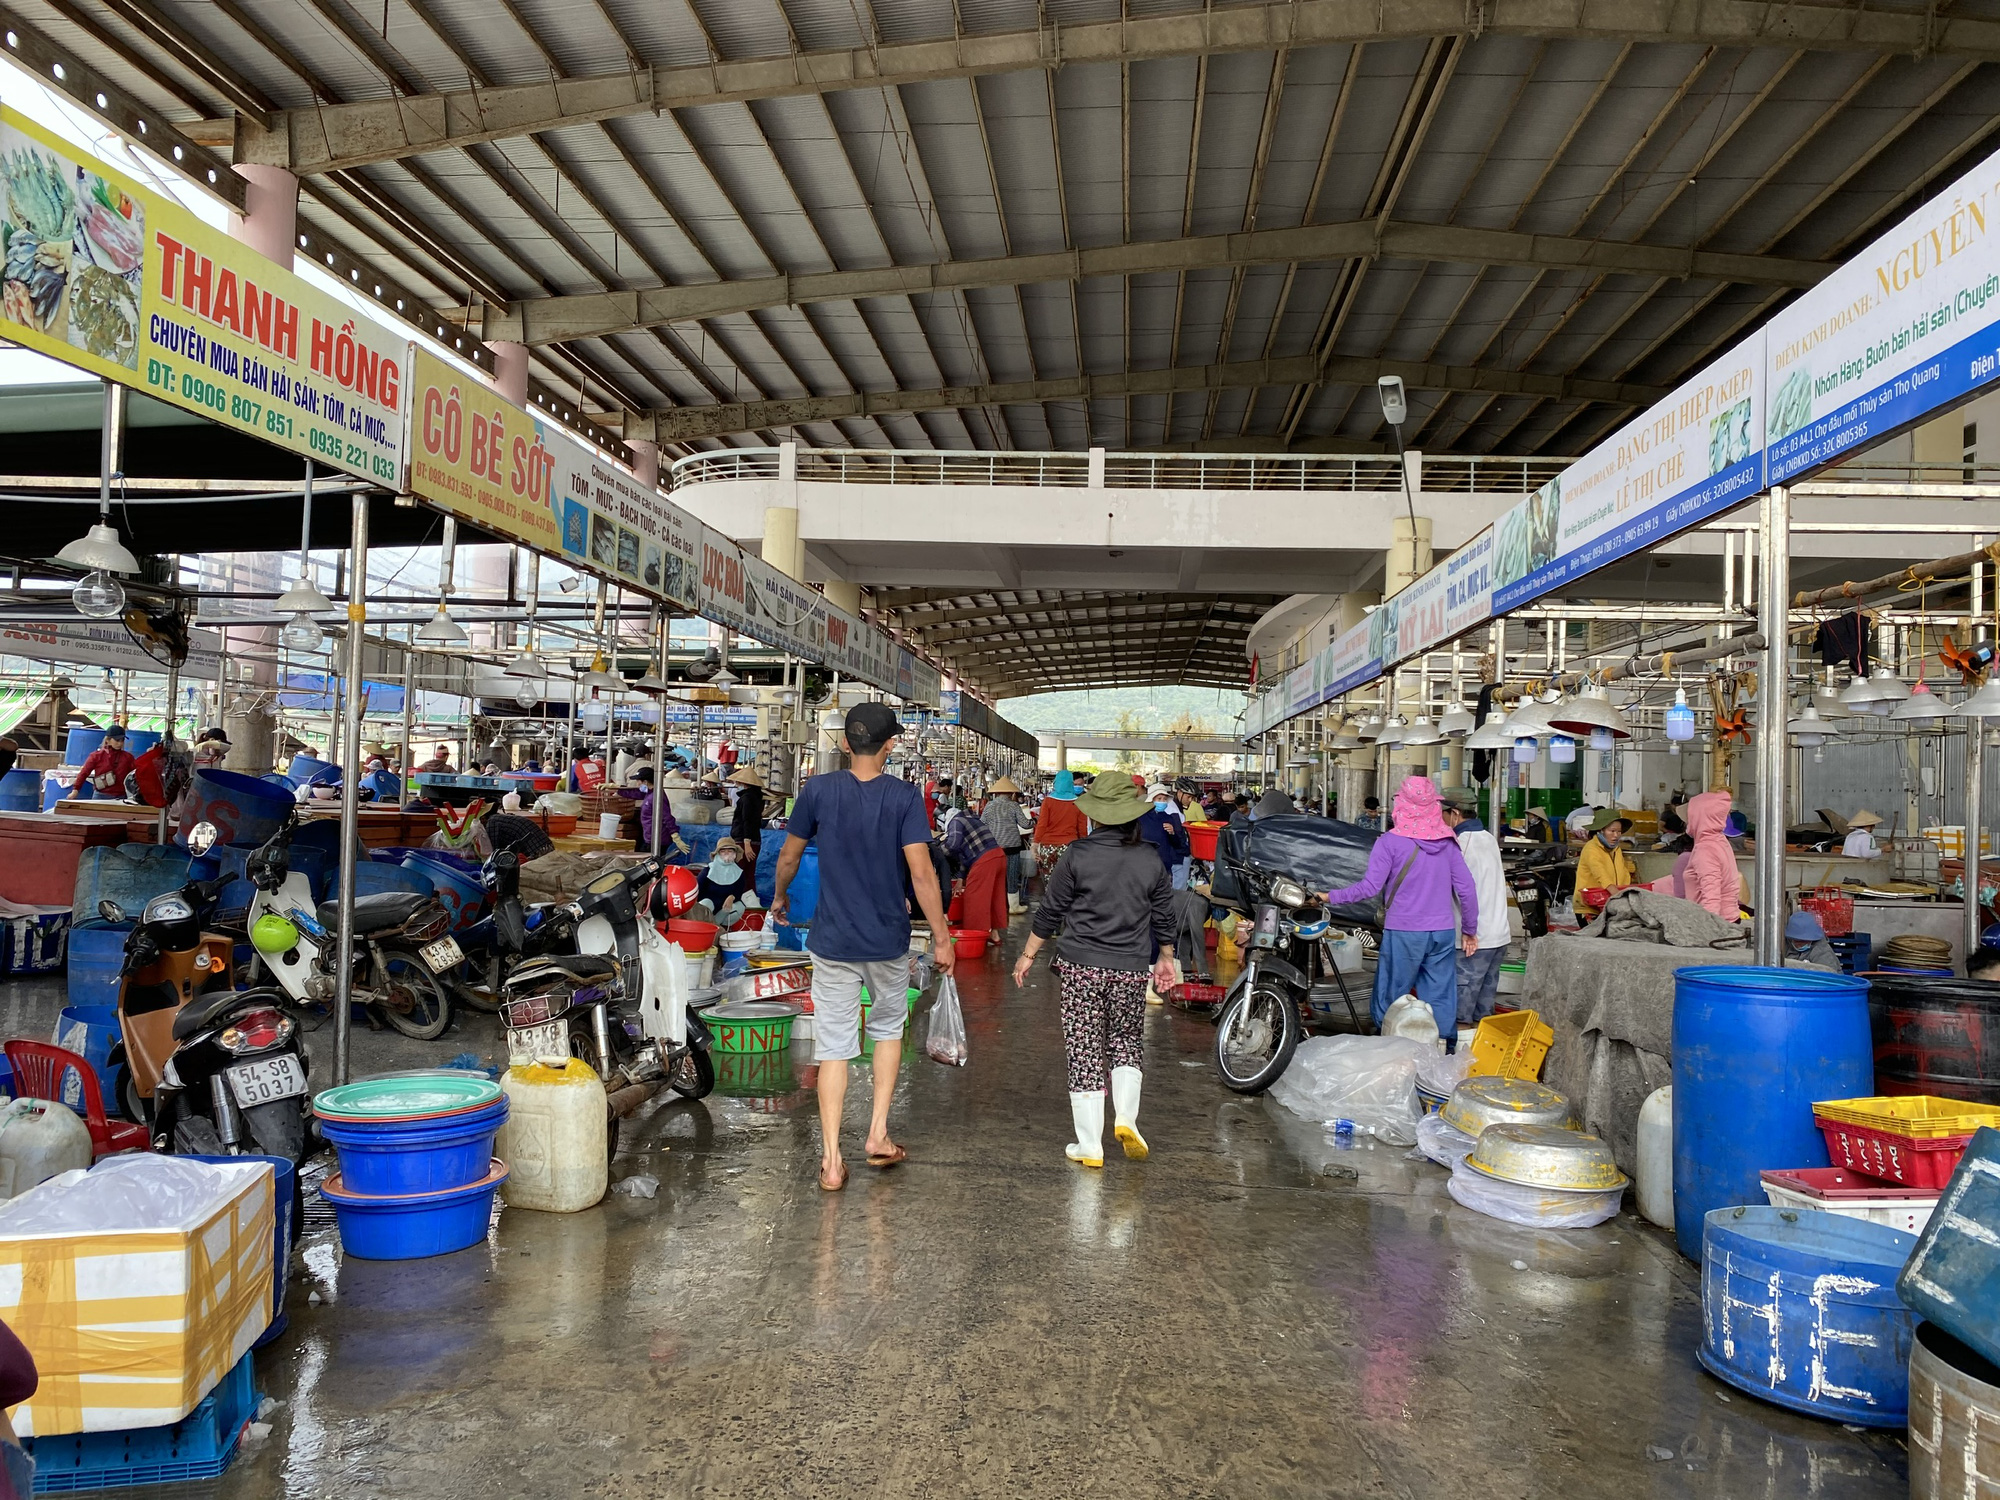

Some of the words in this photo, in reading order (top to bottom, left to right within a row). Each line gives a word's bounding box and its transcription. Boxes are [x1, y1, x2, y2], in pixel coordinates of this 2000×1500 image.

[1875, 192, 1987, 306] NGUYỄN
[156, 232, 299, 365] THANH
[310, 319, 399, 413] HỒNG
[1802, 322, 1827, 353] KINH
[1830, 293, 1872, 336] DOANH:
[1815, 371, 1838, 399] Nhóm
[1840, 357, 1864, 386] Hàng:
[1867, 339, 1889, 369] Buôn
[1892, 327, 1910, 354] bán
[1913, 313, 1929, 340] hải
[1931, 302, 1951, 331] sản
[1954, 273, 1999, 322] (Chuyên
[150, 314, 206, 365] CHUYÊN
[210, 341, 239, 380] MUA
[242, 355, 268, 392] BÁN
[271, 365, 291, 402] HẢI
[293, 376, 319, 415] SẢN:
[323, 392, 347, 430] TÔM,
[350, 405, 362, 435] CÁ
[1971, 354, 1995, 380] Điện
[147, 358, 175, 392] ĐT:
[181, 373, 226, 412] 0906
[231, 395, 261, 426] 807
[266, 410, 293, 439] 851
[309, 428, 342, 460] 0935
[346, 443, 367, 470] 221
[373, 457, 395, 481] 033
[1652, 410, 1676, 447] THỊ
[1679, 385, 1714, 431] HIỆP
[1716, 366, 1753, 411] (KIỆP)
[1790, 437, 1798, 452] 03
[1814, 421, 1827, 441] Chợ
[1843, 405, 1858, 425] mối
[1879, 385, 1893, 406] sản
[1894, 379, 1910, 398] Thọ
[1911, 363, 1940, 390] Quang
[423, 386, 462, 465] CÔ
[469, 411, 504, 486] BÊ
[511, 433, 556, 509] SỚT
[1822, 439, 1835, 456] 32C
[572, 473, 589, 499] TÔM
[596, 487, 614, 512] MỰC
[620, 500, 638, 527] BẠCH
[640, 513, 656, 537] TUỘC
[661, 525, 670, 545] CÁ
[671, 532, 681, 550] các
[592, 464, 615, 489] Chuyên
[616, 482, 628, 496] mua
[641, 495, 651, 510] các
[1616, 476, 1630, 514] LÊ
[1633, 468, 1655, 503] THỊ
[765, 577, 778, 596] HẢI
[780, 585, 794, 604] SẢN
[1420, 595, 1444, 645] LAI
[239, 1059, 290, 1085] 54-S8
[245, 1075, 293, 1101] 5037
